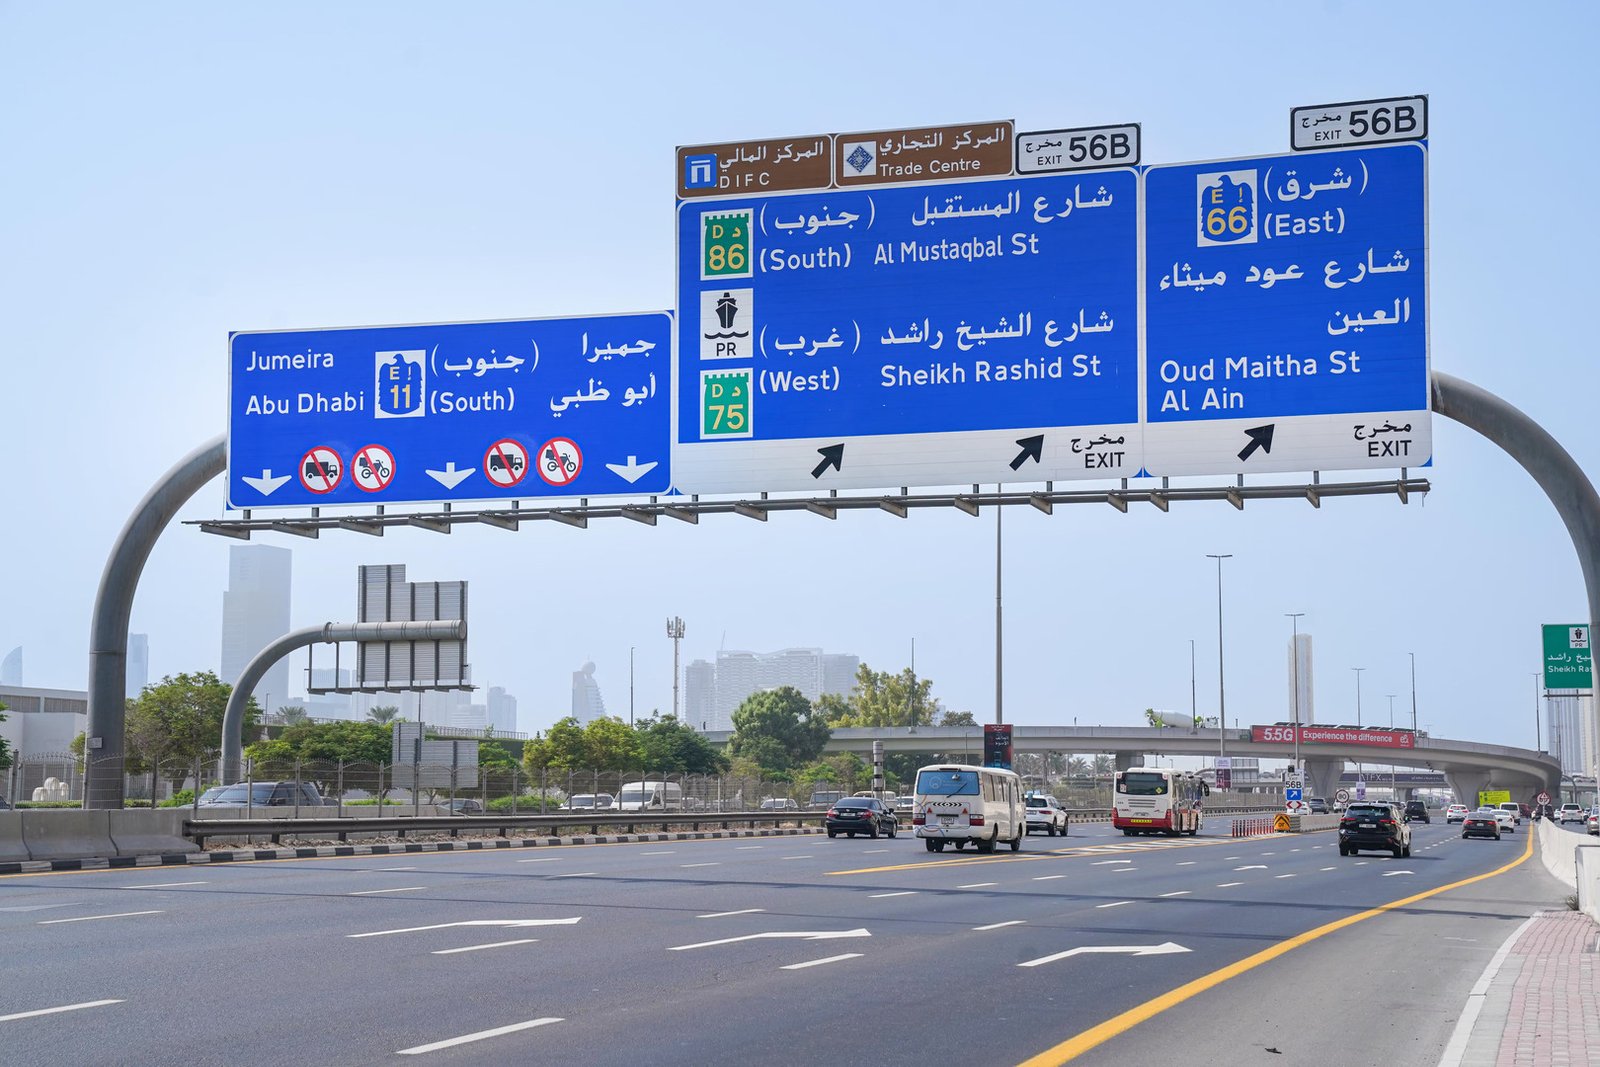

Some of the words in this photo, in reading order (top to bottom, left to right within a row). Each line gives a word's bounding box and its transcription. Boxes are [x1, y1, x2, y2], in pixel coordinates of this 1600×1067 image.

[1302, 113, 1342, 129] مخرج
[1350, 106, 1417, 138] 56B
[879, 133, 943, 156] التجاري
[952, 128, 1006, 150] المركز
[1025, 138, 1063, 154] مخرج
[1069, 132, 1131, 163] 56B
[1315, 130, 1342, 141] EXIT
[719, 145, 767, 170] المالي
[772, 141, 825, 163] المركز
[1037, 154, 1063, 166] EXIT
[879, 161, 923, 178] Trade
[929, 158, 981, 174] Centre
[912, 190, 1020, 227] المستقبل
[1033, 184, 1113, 223] شارع
[1212, 189, 1224, 204] E
[712, 224, 724, 239] D
[1206, 206, 1248, 235] 66
[1264, 208, 1345, 239] (East)
[708, 244, 745, 271] 86
[759, 243, 851, 273] (South)
[874, 243, 895, 265] Al
[900, 234, 1003, 263] Mustaqbal
[1011, 232, 1039, 256] St
[1159, 262, 1227, 292] ميثاء
[1245, 264, 1304, 289] عود
[1324, 247, 1410, 289] شارع
[1044, 309, 1114, 347] شارع
[1327, 296, 1410, 336] العين
[880, 317, 944, 350] راشد
[955, 311, 1032, 351] الشيخ
[582, 332, 657, 363] جميرا
[715, 342, 737, 358] PR
[246, 349, 334, 372] Jumeira
[880, 362, 966, 387] Sheikh
[975, 356, 1062, 382] Rashid
[1072, 354, 1101, 377] St
[1160, 358, 1214, 383] Oud
[1225, 353, 1318, 380] Maitha
[1329, 350, 1361, 374] St
[389, 366, 400, 381] E
[759, 366, 840, 394] (West)
[390, 384, 411, 409] 11
[430, 387, 515, 414] (South)
[550, 377, 611, 418] ظبي
[621, 371, 656, 407] أبو
[711, 383, 724, 398] D
[1160, 389, 1190, 412] Al
[1201, 386, 1244, 410] Ain
[245, 394, 289, 416] Abu
[297, 390, 364, 413] Dhabi
[708, 404, 744, 432] 75
[1353, 419, 1413, 440] مخرج
[1070, 433, 1125, 453] مخرج
[1368, 439, 1412, 458] EXIT
[1084, 452, 1125, 469] EXIT
[1547, 652, 1572, 663] راشد
[1547, 665, 1577, 673] Sheikh
[1263, 727, 1294, 742] 5.5G
[1302, 730, 1345, 741] Experience
[1345, 731, 1358, 741] the
[1358, 732, 1393, 743] difference
[1285, 780, 1302, 789] 56B
